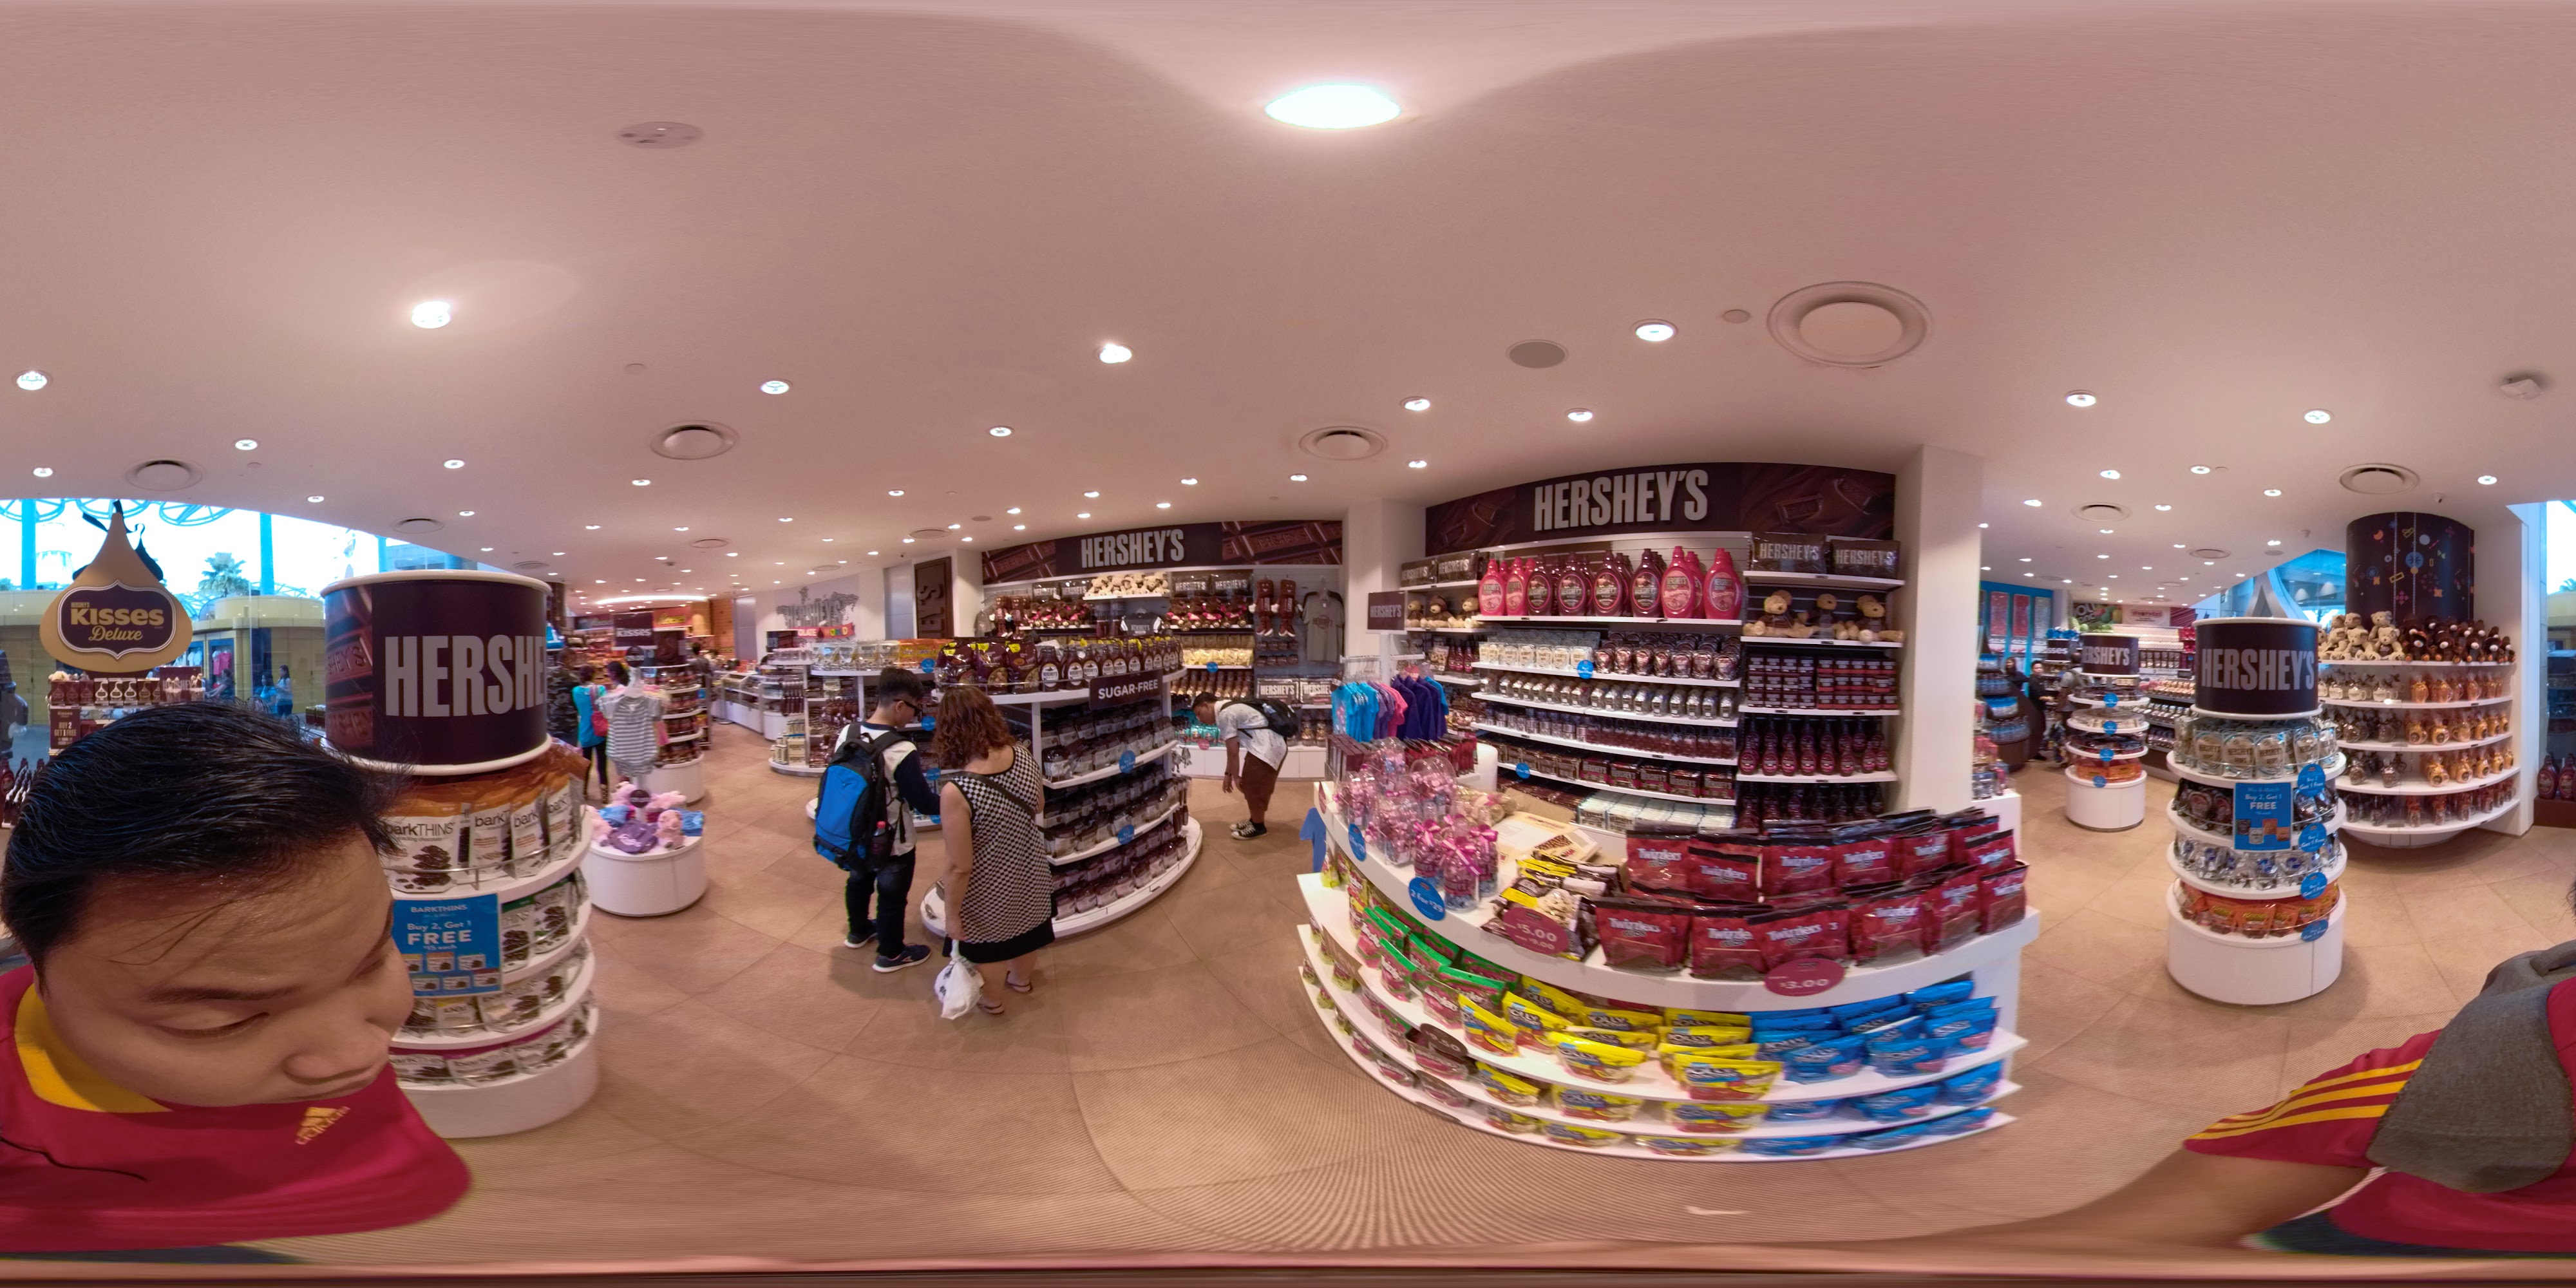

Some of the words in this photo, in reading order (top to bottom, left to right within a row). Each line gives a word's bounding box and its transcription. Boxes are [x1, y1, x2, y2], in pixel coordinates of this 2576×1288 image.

[1534, 468, 1709, 532] HERSHEY'S
[1081, 528, 1185, 569] HERSHEY'S
[1760, 543, 1819, 560] HERSHEY'S
[1836, 549, 1896, 565] HERSHEY'S
[1402, 567, 1428, 580] HERSHEY'S
[1438, 558, 1470, 574] HERSHEY'S
[1175, 581, 1206, 591] HERSHEY'S
[1214, 580, 1248, 590] HERSHEY'S
[1370, 604, 1402, 618] HERSHEY'S
[88, 625, 144, 641] Deluxe
[2202, 649, 2316, 692] HERSHEY'S
[1098, 678, 1159, 700] SUGAR-FREE
[1260, 685, 1295, 696] HERSHEY'S
[2249, 802, 2278, 810] FREE
[386, 822, 453, 837] barkTHINS
[1637, 848, 1682, 861] Twizzlers
[1842, 849, 1886, 864] Twizzlers
[1700, 865, 1748, 880] Twizzlers
[1410, 889, 1416, 898] 2
[1417, 893, 1430, 905] for
[411, 904, 468, 913] BARKTHINS
[407, 923, 428, 933] Buy
[1516, 922, 1558, 942] $5.00
[1607, 917, 1662, 934] Twizzlers
[1766, 923, 1822, 941] Twizzlers
[407, 929, 473, 945] FREE
[1707, 927, 1753, 941] Twizzle
[1528, 938, 1556, 951] $9.00
[1779, 978, 1830, 989] $3.00
